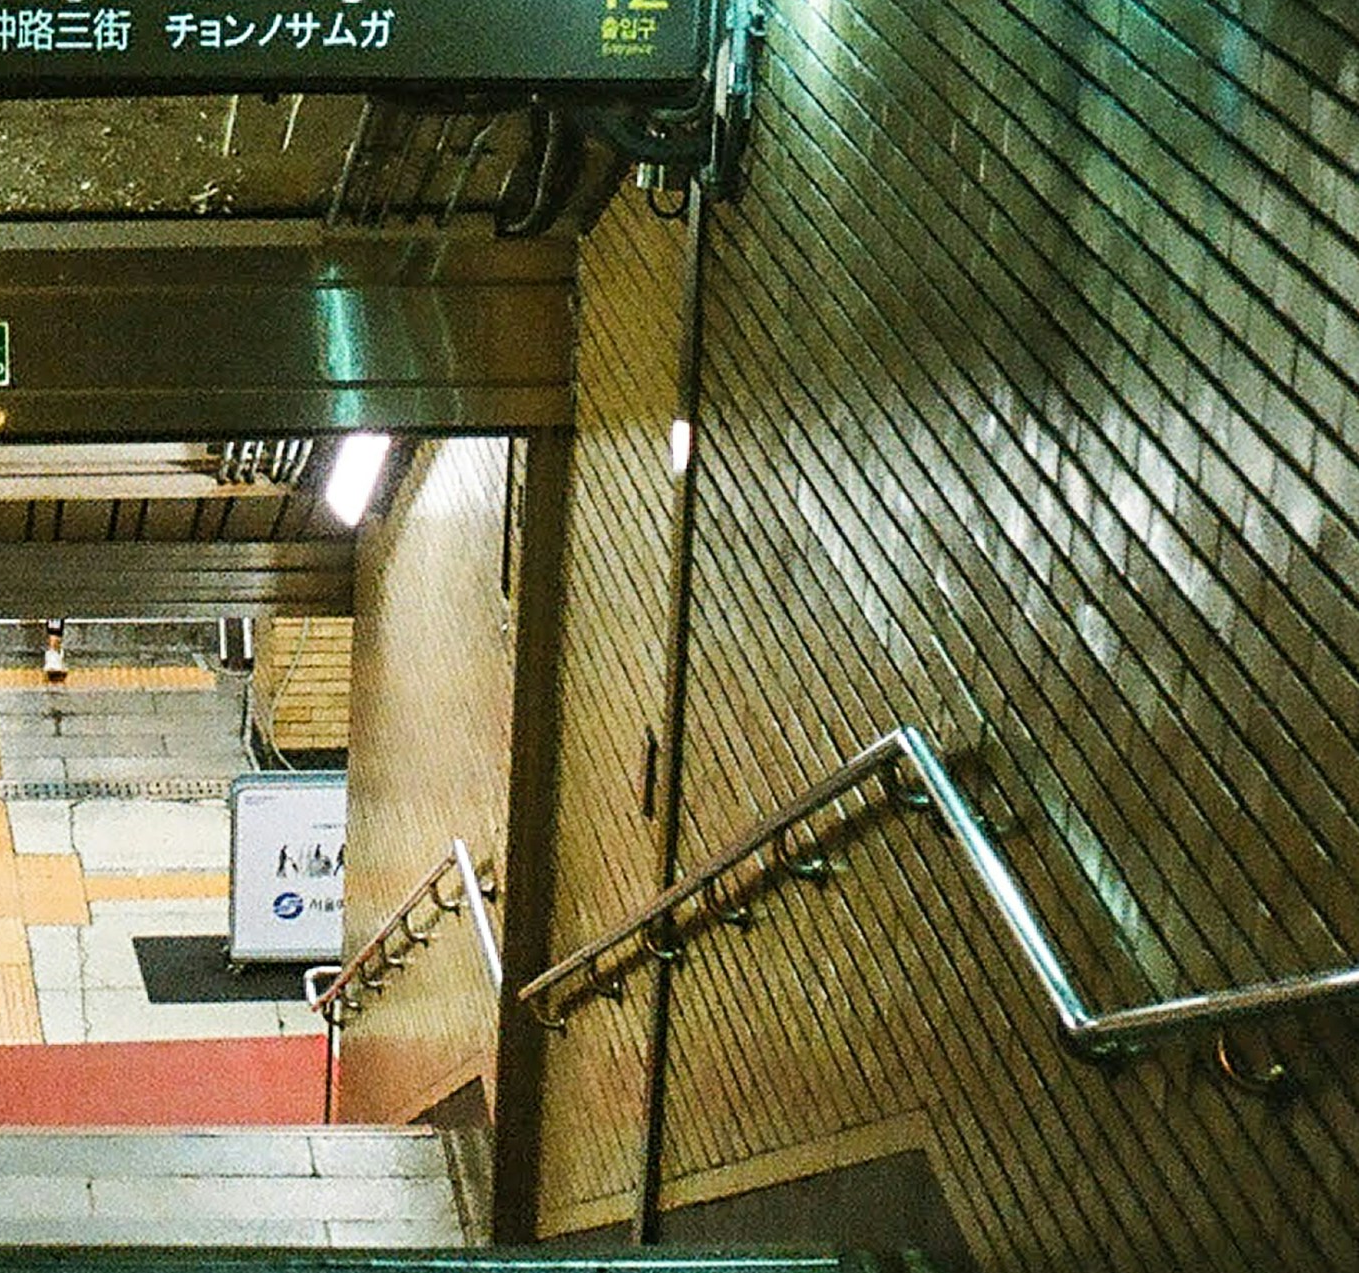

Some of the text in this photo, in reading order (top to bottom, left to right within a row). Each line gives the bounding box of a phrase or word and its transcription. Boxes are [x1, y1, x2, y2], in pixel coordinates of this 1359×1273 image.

[165, 8, 393, 50] チョンノサムガ
